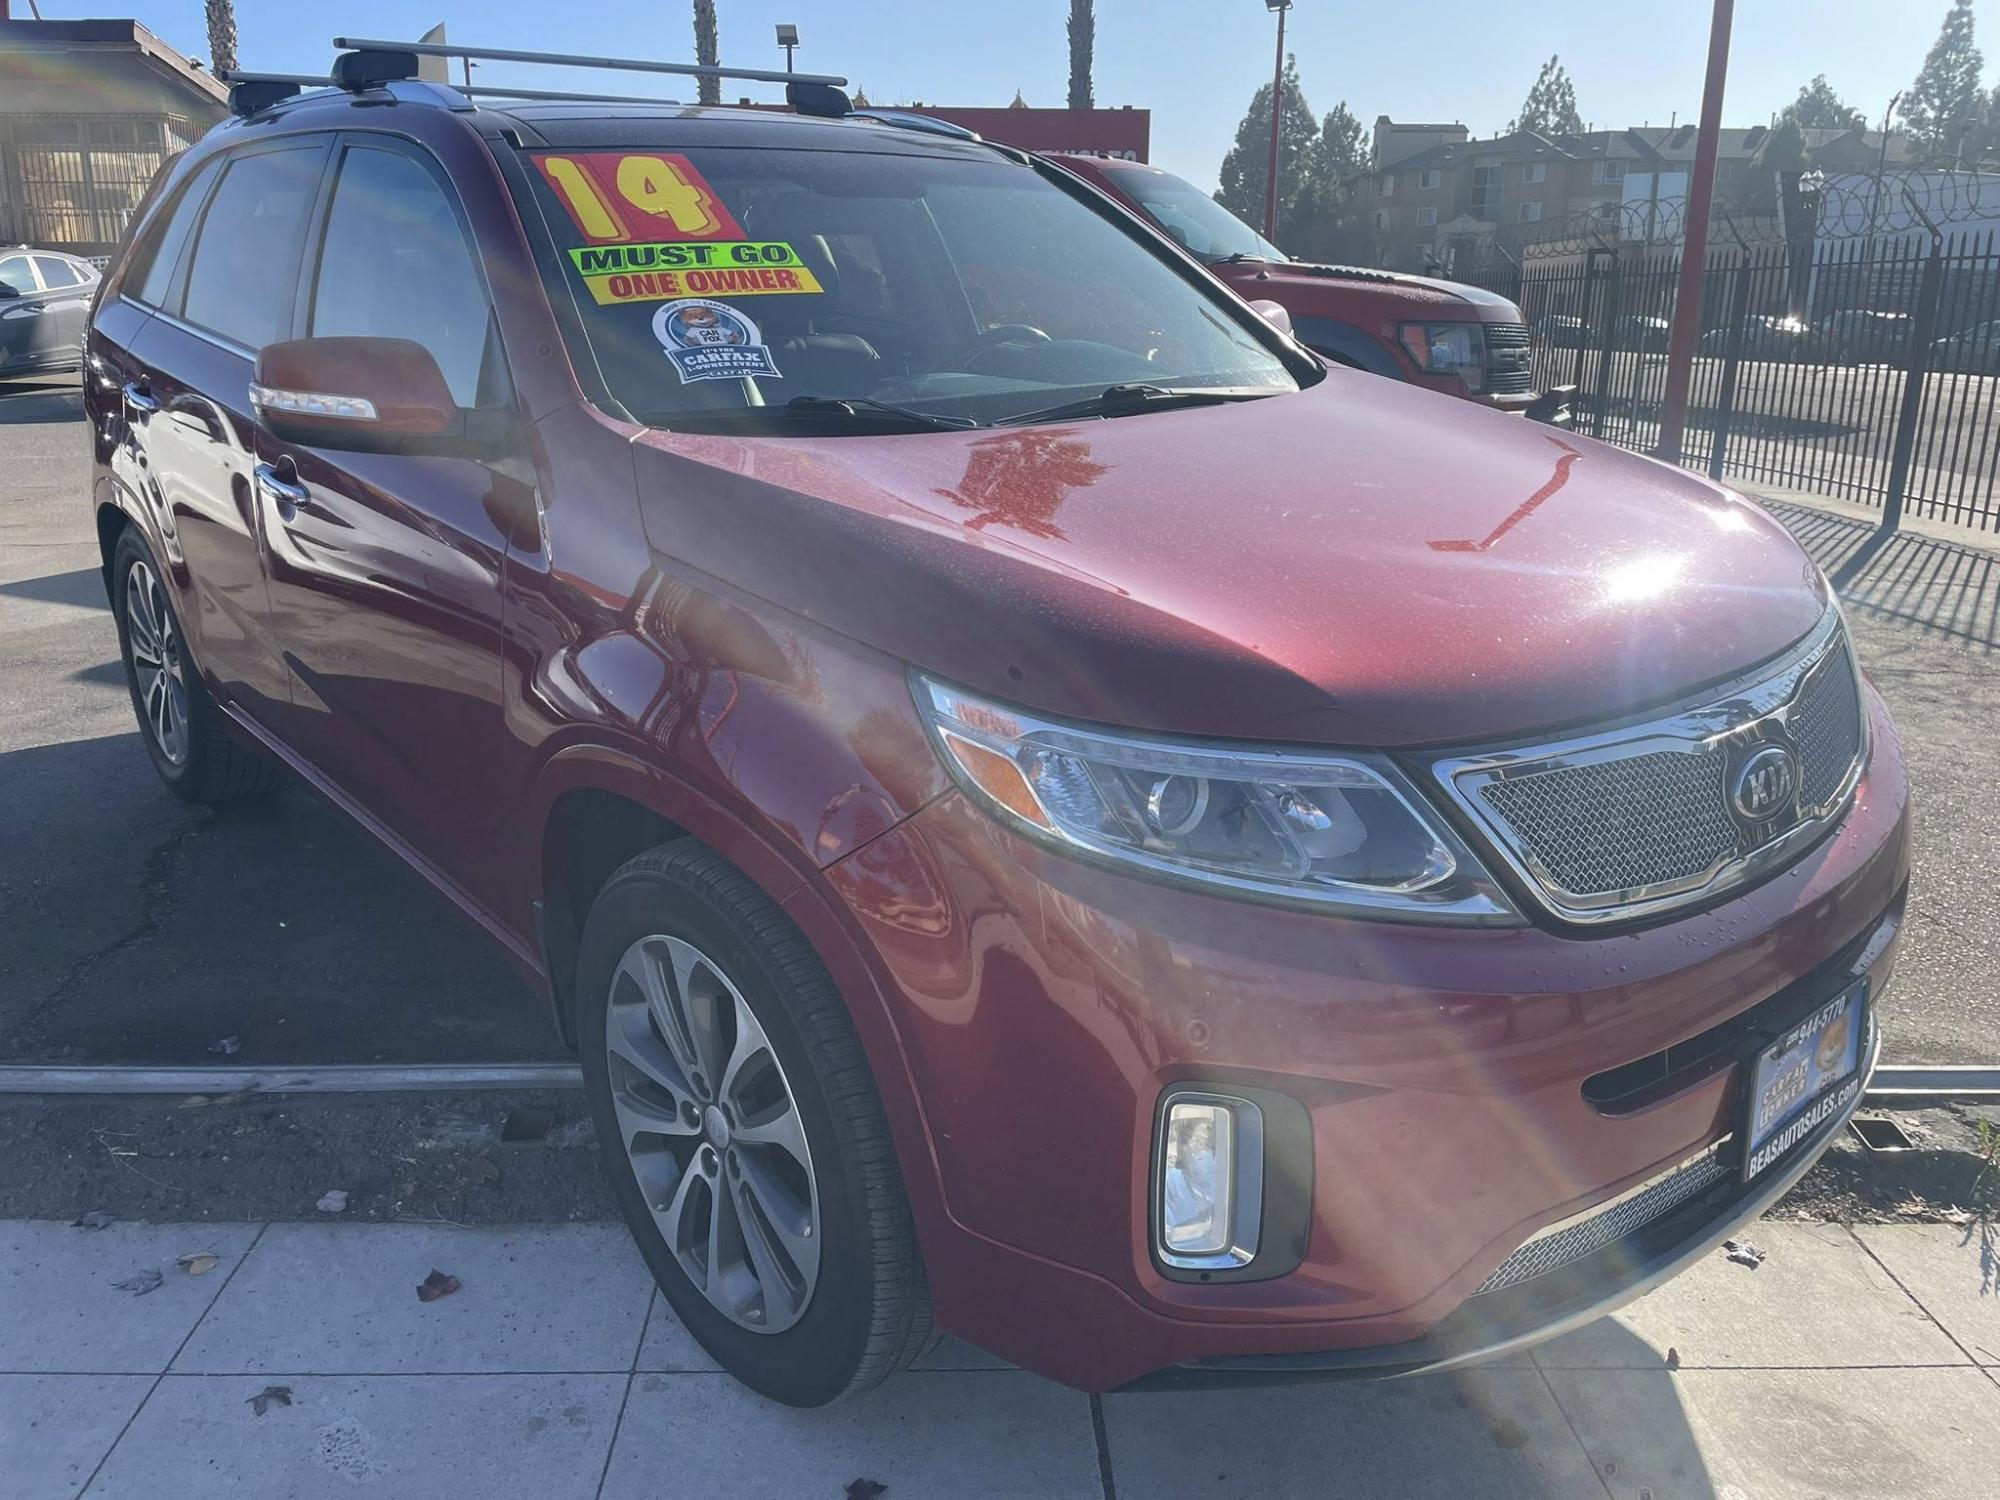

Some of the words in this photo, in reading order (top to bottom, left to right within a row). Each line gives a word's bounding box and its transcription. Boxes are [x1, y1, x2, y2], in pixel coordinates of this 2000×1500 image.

[544, 155, 721, 241] 14
[581, 245, 716, 272] MUST
[731, 245, 792, 265] GO
[608, 271, 681, 298] ONE
[685, 269, 800, 293] OWNER
[699, 329, 719, 337] CAR
[684, 352, 762, 365] CARFAX
[687, 362, 732, 372] 1-OWNER
[1747, 760, 1792, 809] KIA
[1798, 995, 1846, 1044] 944-5770
[1749, 1078, 1859, 1180] BEASAUTOSALES.com
